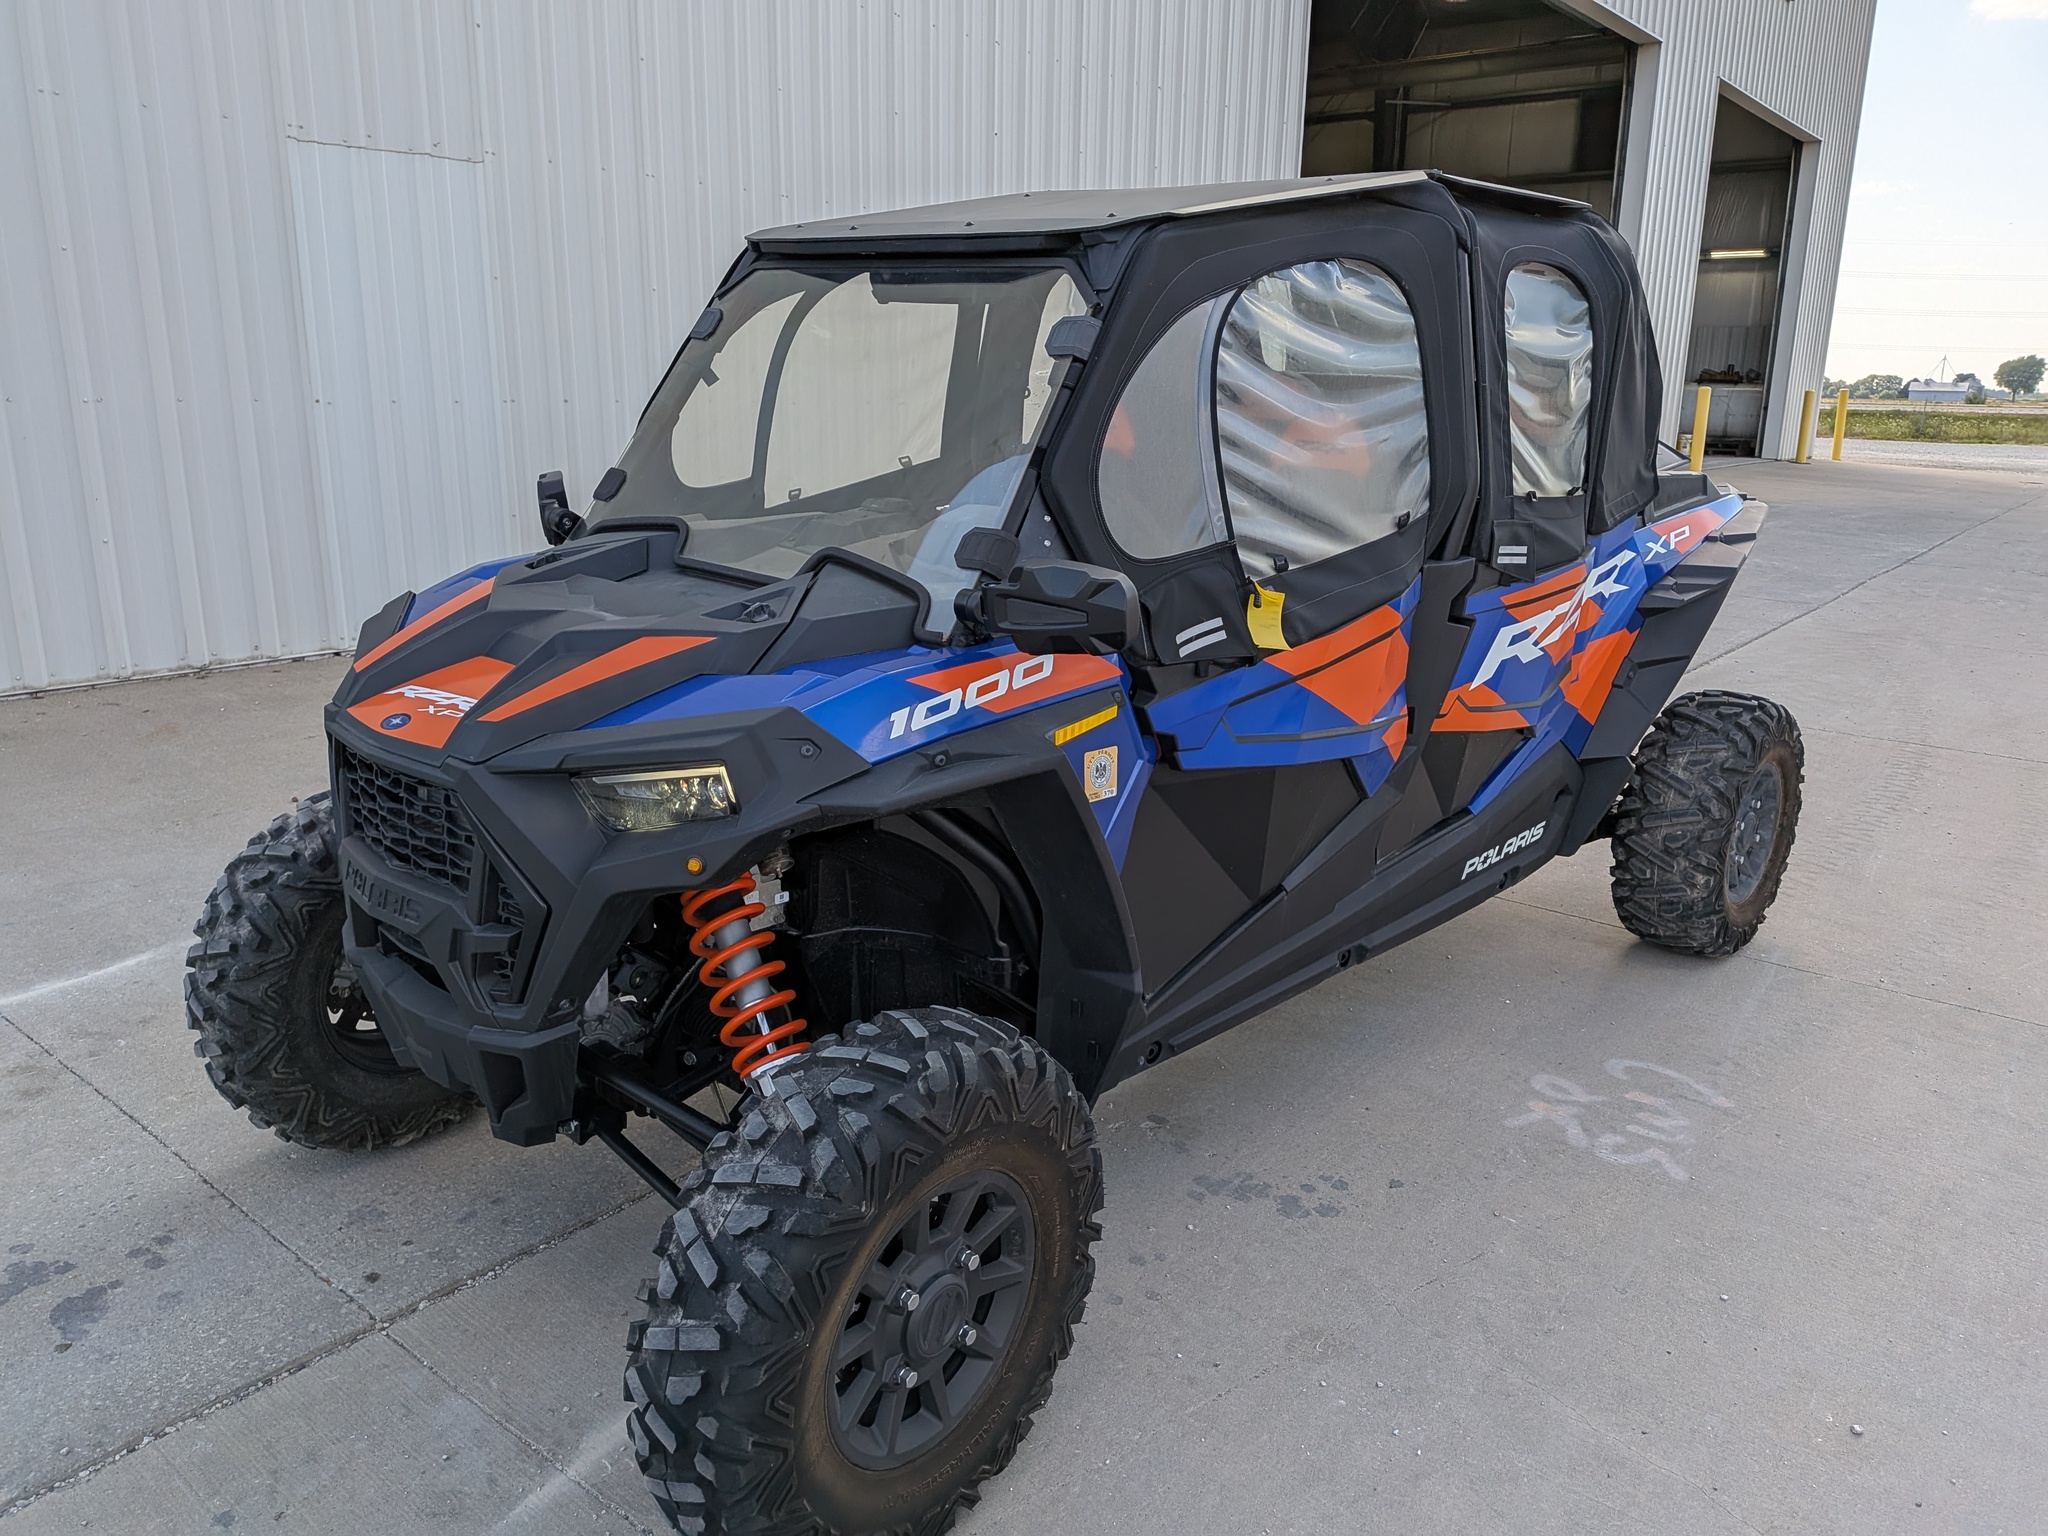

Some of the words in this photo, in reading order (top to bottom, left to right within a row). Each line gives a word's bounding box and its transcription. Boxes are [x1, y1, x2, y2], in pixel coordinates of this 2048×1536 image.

[1469, 549, 1637, 691] RZR
[1644, 525, 1690, 562] XP
[383, 684, 479, 711] RZR
[417, 705, 465, 718] XP
[889, 654, 1054, 740] 1000
[1103, 789, 1115, 797] 370
[1461, 821, 1546, 880] POLARIS
[345, 859, 424, 924] POLARIS
